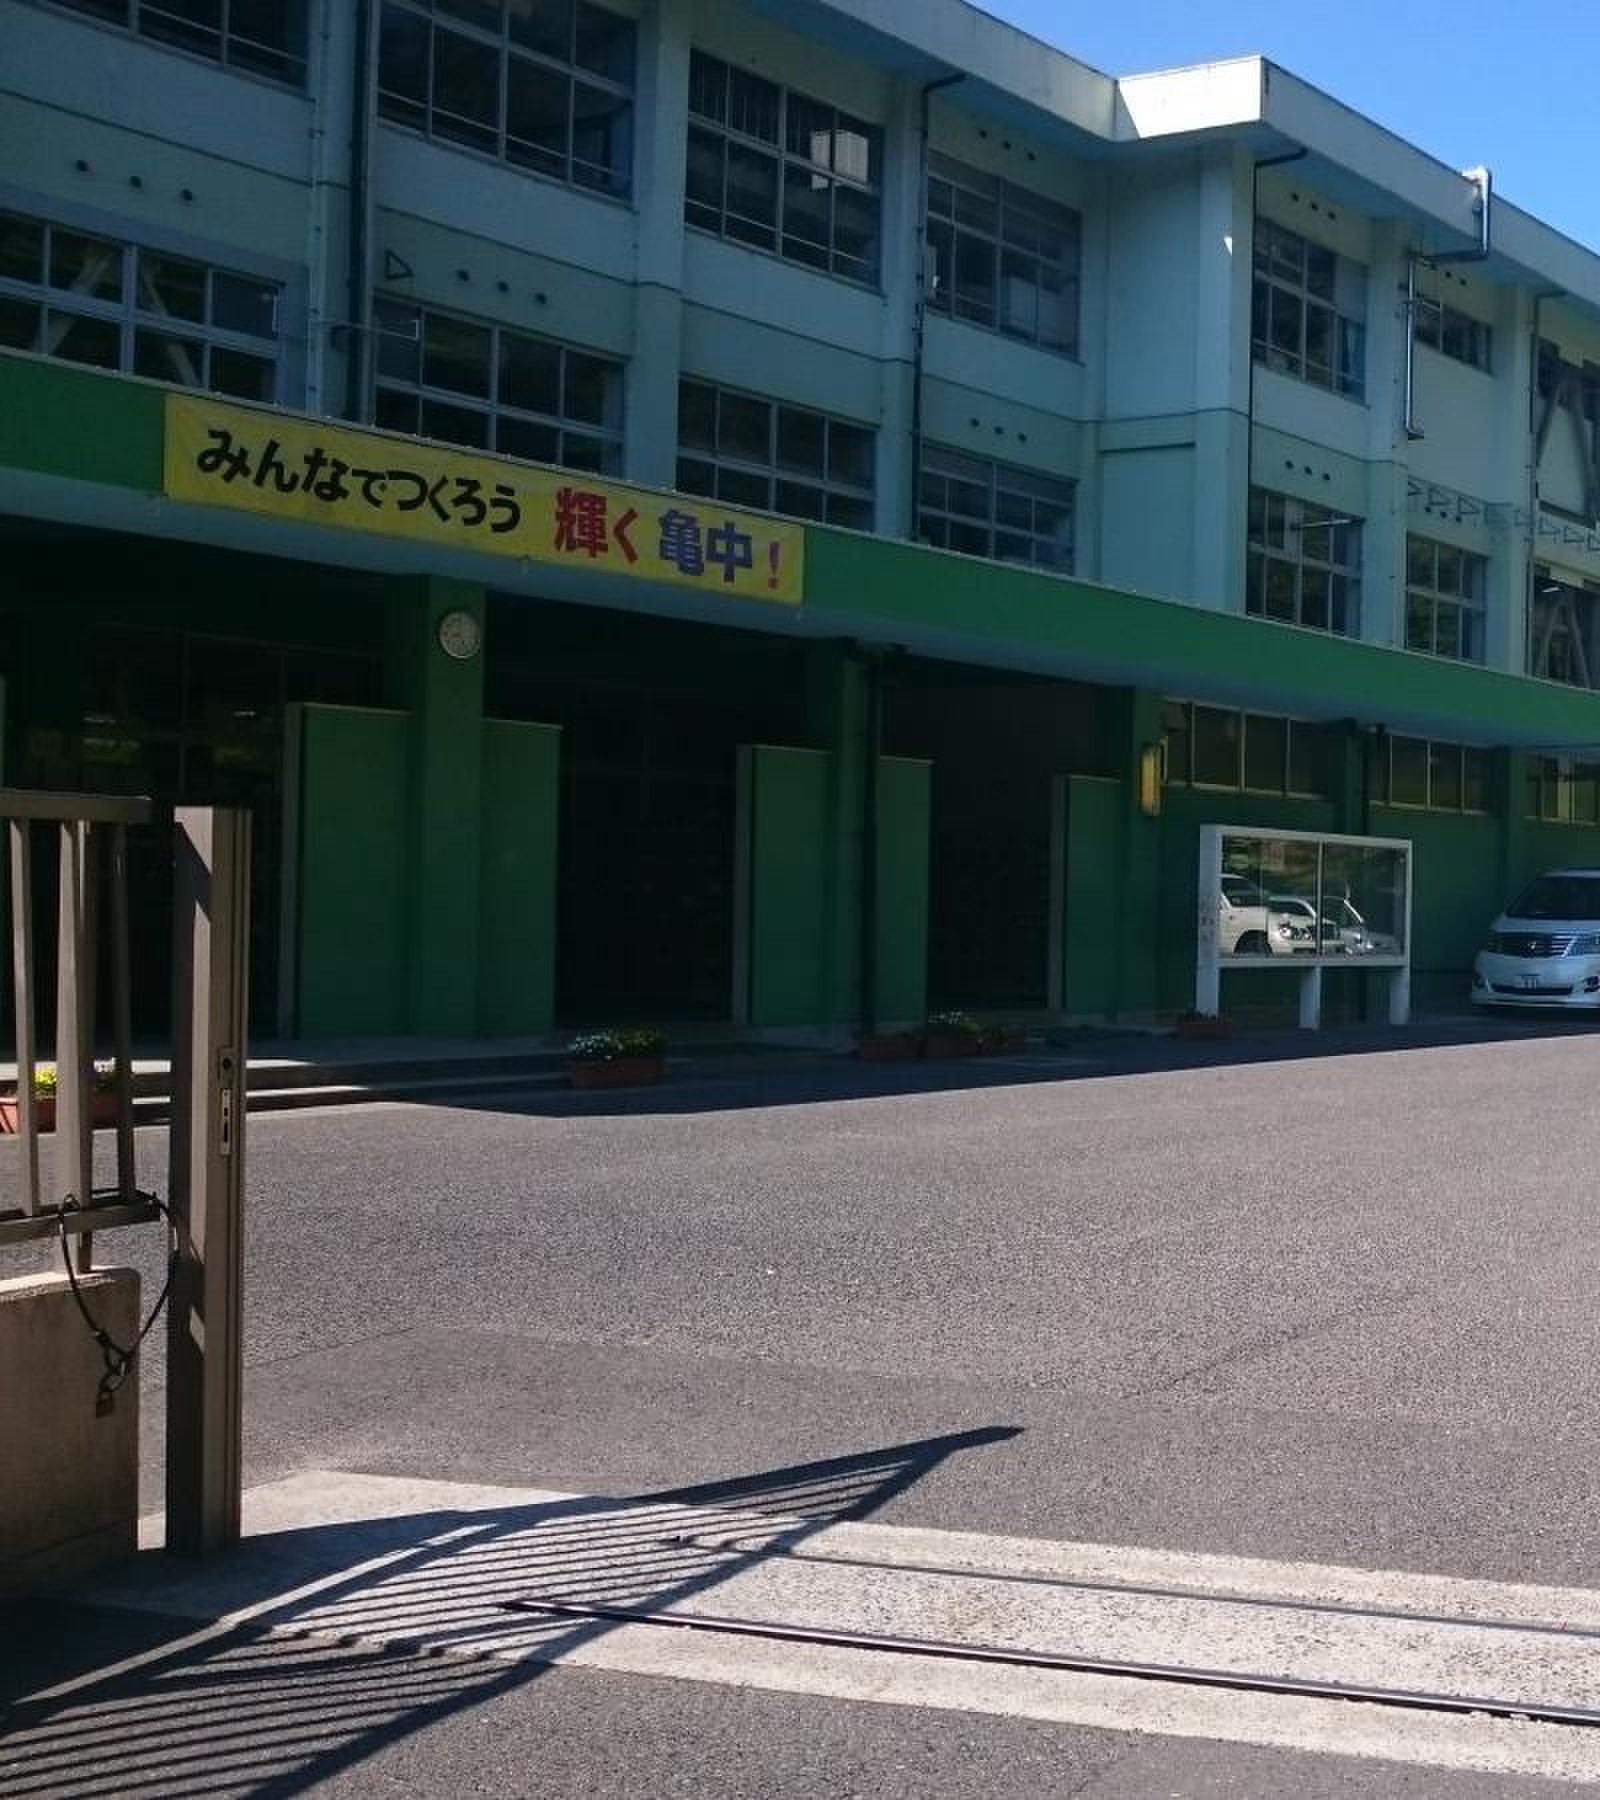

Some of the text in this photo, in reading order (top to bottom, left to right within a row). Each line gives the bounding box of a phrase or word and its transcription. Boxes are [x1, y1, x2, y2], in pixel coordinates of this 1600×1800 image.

[197, 428, 521, 534] みんなでつくろう
[554, 486, 639, 564] 輝く
